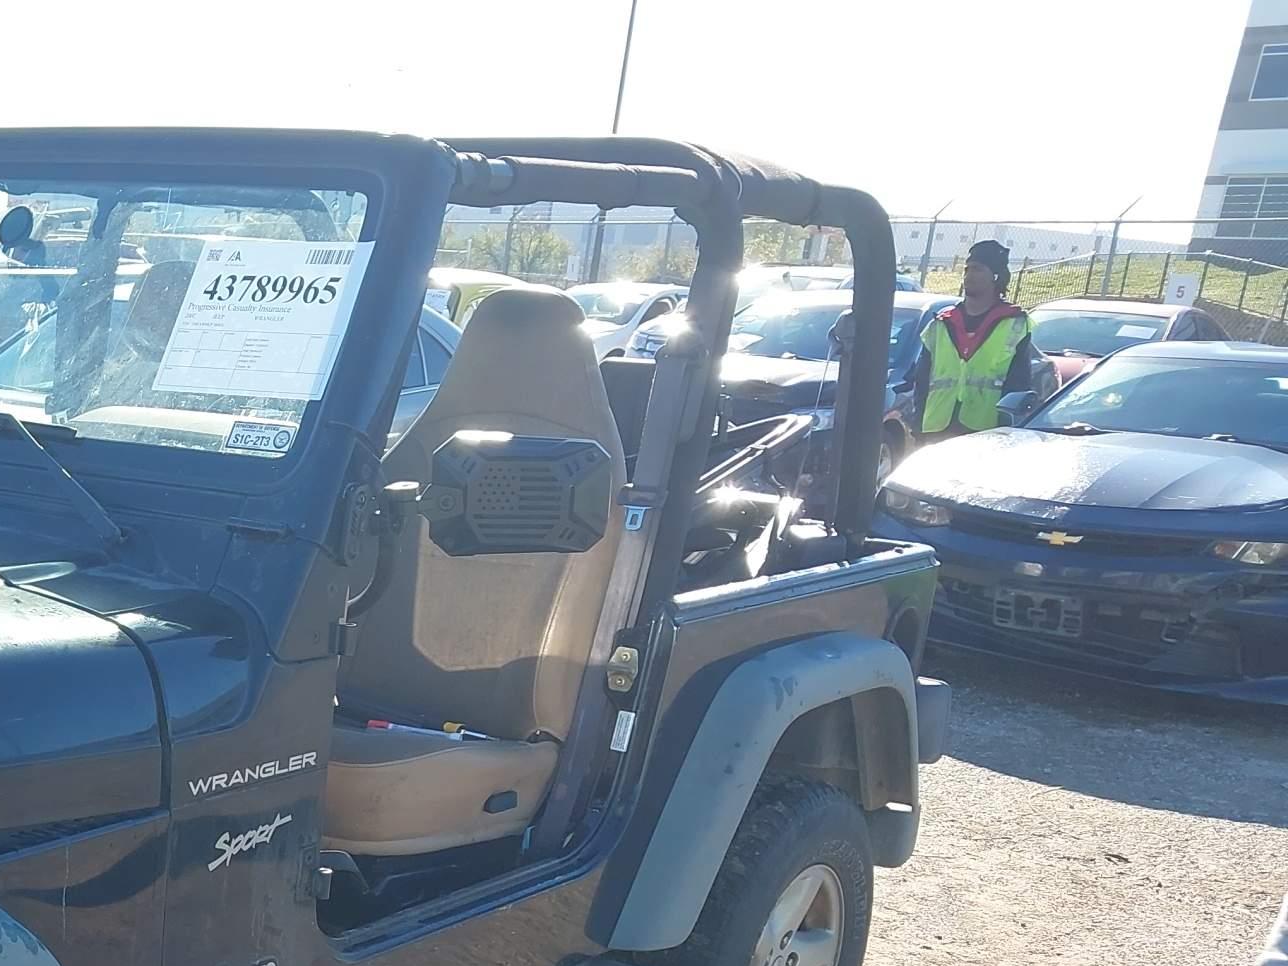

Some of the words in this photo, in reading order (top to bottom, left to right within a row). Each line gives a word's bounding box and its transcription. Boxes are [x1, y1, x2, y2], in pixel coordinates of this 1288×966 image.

[202, 273, 343, 304] 43789965
[1175, 285, 1186, 299] 5
[187, 302, 226, 312] Progressive
[227, 303, 258, 314] Casualty
[258, 304, 292, 313] Insurance
[232, 433, 271, 447] S1C-2T3
[188, 751, 317, 796] WRANGLER
[207, 812, 293, 872] Sport
